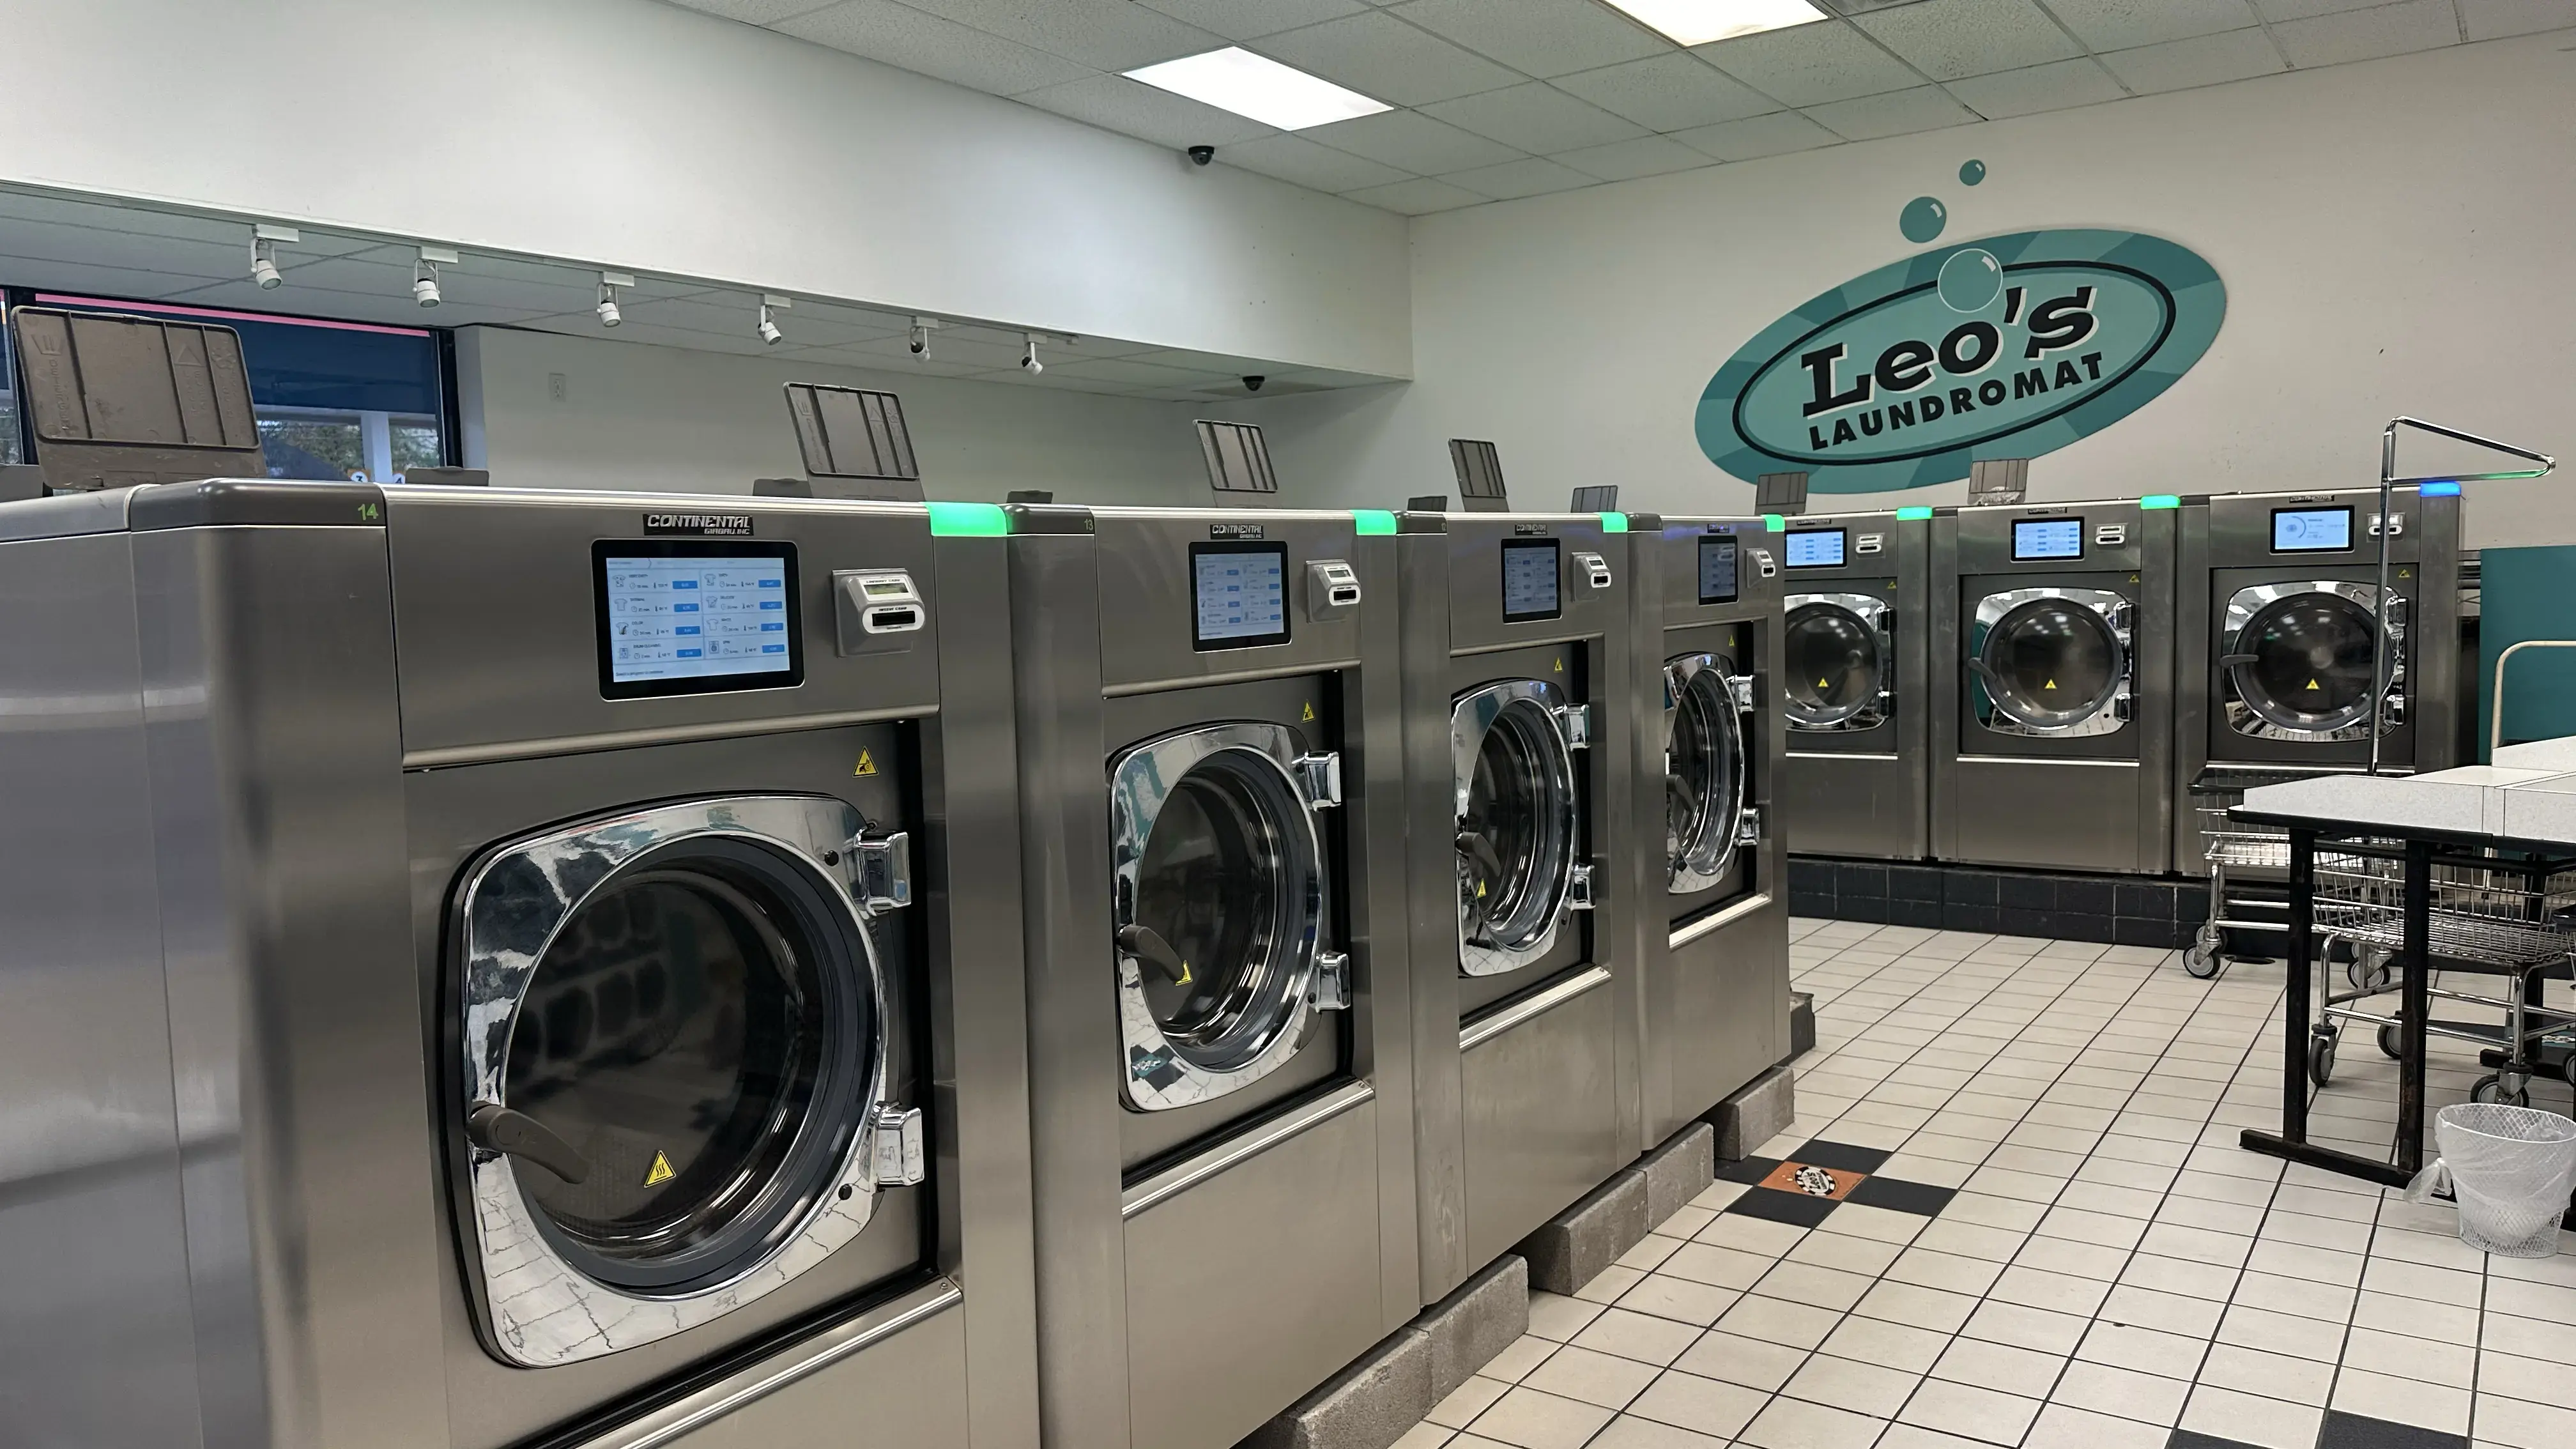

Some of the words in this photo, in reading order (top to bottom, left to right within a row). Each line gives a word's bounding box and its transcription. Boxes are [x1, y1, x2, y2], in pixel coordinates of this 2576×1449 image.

[1801, 286, 2098, 419] Leo's
[1808, 351, 2104, 450] LAUNDROMAT
[358, 503, 379, 521] 14
[647, 515, 750, 527] CONTINENTAL
[1084, 518, 1094, 531] 13
[1212, 525, 1262, 533] CONTINENTAL
